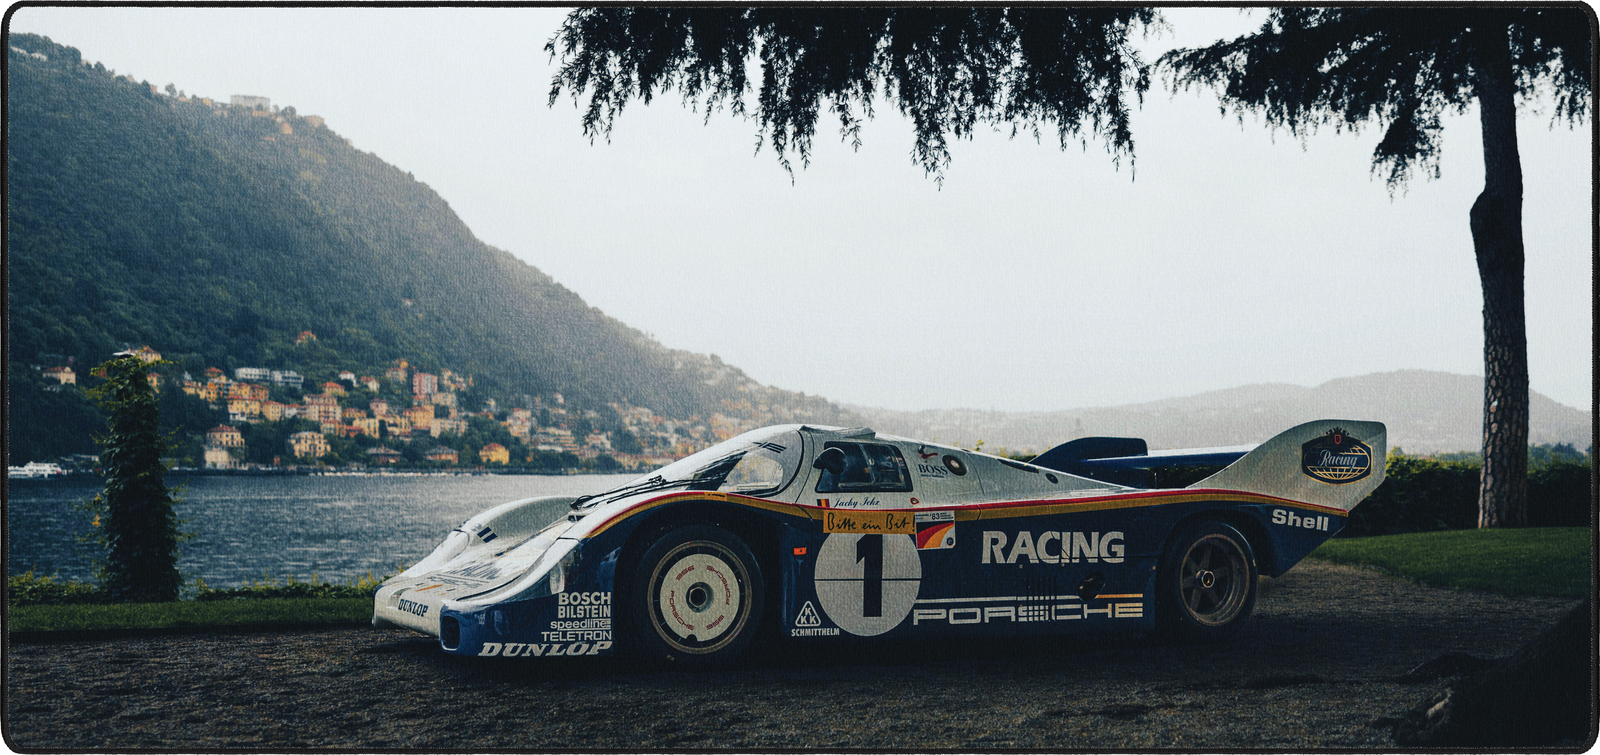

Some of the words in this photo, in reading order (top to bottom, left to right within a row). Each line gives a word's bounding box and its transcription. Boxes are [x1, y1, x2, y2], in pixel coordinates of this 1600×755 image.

[1318, 449, 1358, 469] Racing
[918, 464, 948, 475] BOSS
[833, 498, 858, 508] Jacky
[827, 512, 857, 531] Bitte
[862, 521, 881, 530] ein
[886, 513, 915, 532] Bit!
[1272, 509, 1329, 531] Shell
[981, 530, 1125, 564] RACING
[856, 534, 883, 617] 1
[558, 592, 611, 605] BOSCH
[398, 599, 429, 617] DUNLOP
[558, 605, 611, 618] BILSTEIN
[913, 603, 1143, 625] PORSCHE
[550, 619, 611, 631] speedline
[791, 628, 840, 636] SCHMITTHELM
[541, 630, 612, 641] TELETRON
[478, 641, 612, 656] DUNLOP
